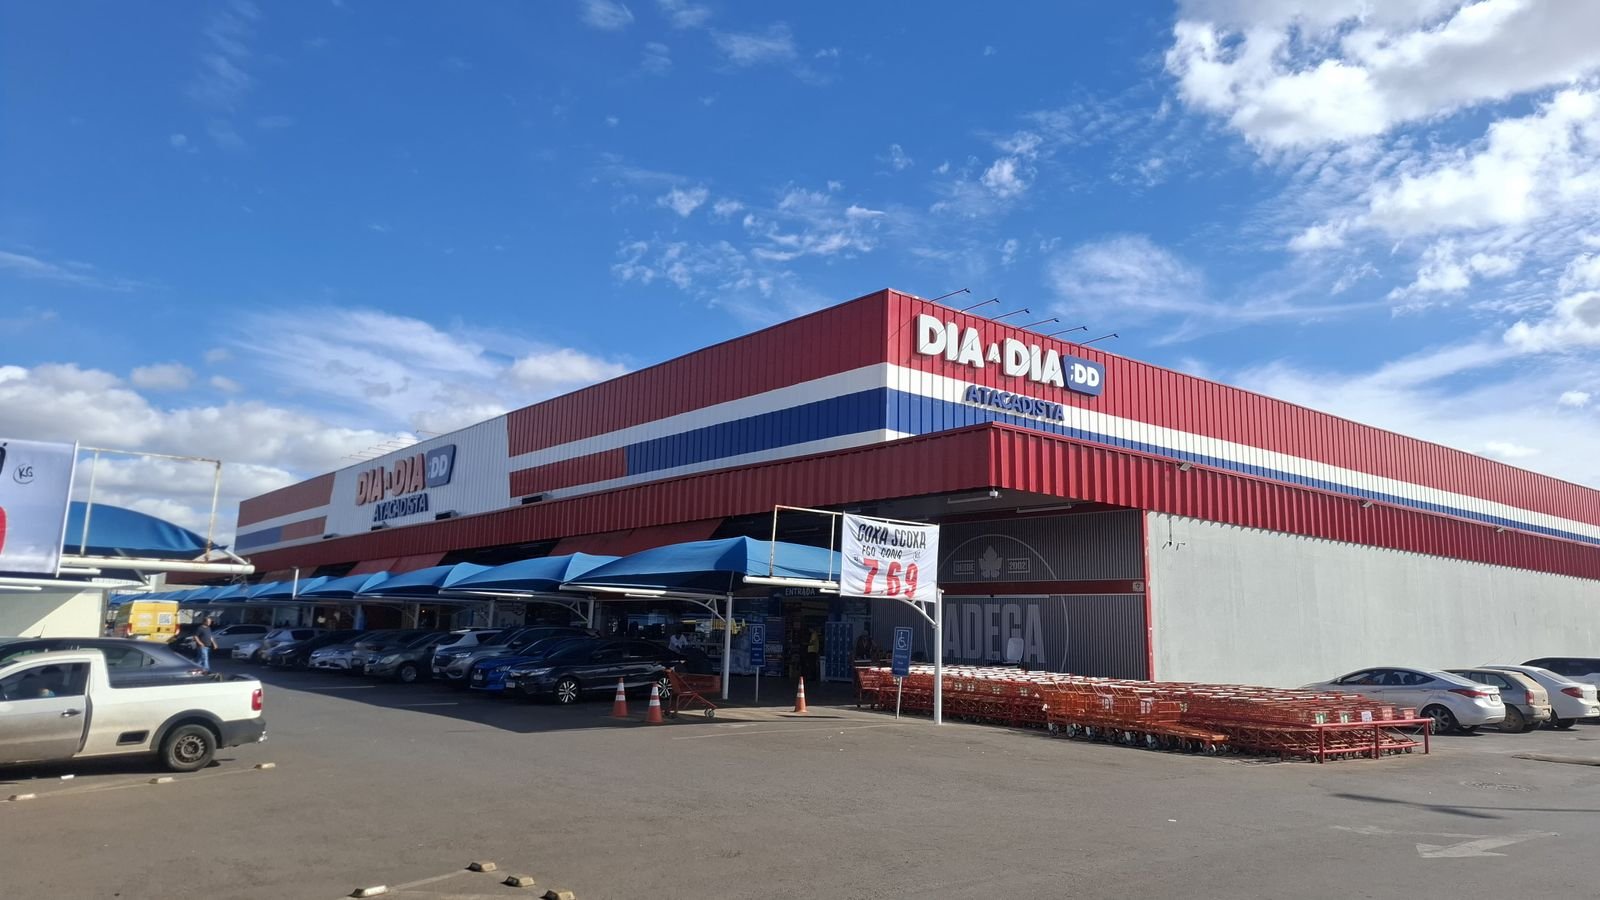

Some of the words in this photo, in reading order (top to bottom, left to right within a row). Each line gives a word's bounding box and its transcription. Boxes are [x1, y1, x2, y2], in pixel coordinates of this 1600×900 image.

[916, 313, 985, 368] DIA
[986, 343, 1001, 364] A
[1003, 337, 1065, 388] DIA
[965, 385, 1065, 421] ATACADISTA
[18, 466, 33, 479] KG
[356, 466, 385, 506] DIA
[392, 453, 426, 496] DIA
[373, 493, 429, 521] ATACADISTA
[857, 523, 889, 546] COXA
[891, 528, 926, 549] SCOXA
[881, 548, 902, 559] CONG
[785, 587, 815, 596] ENTRADA
